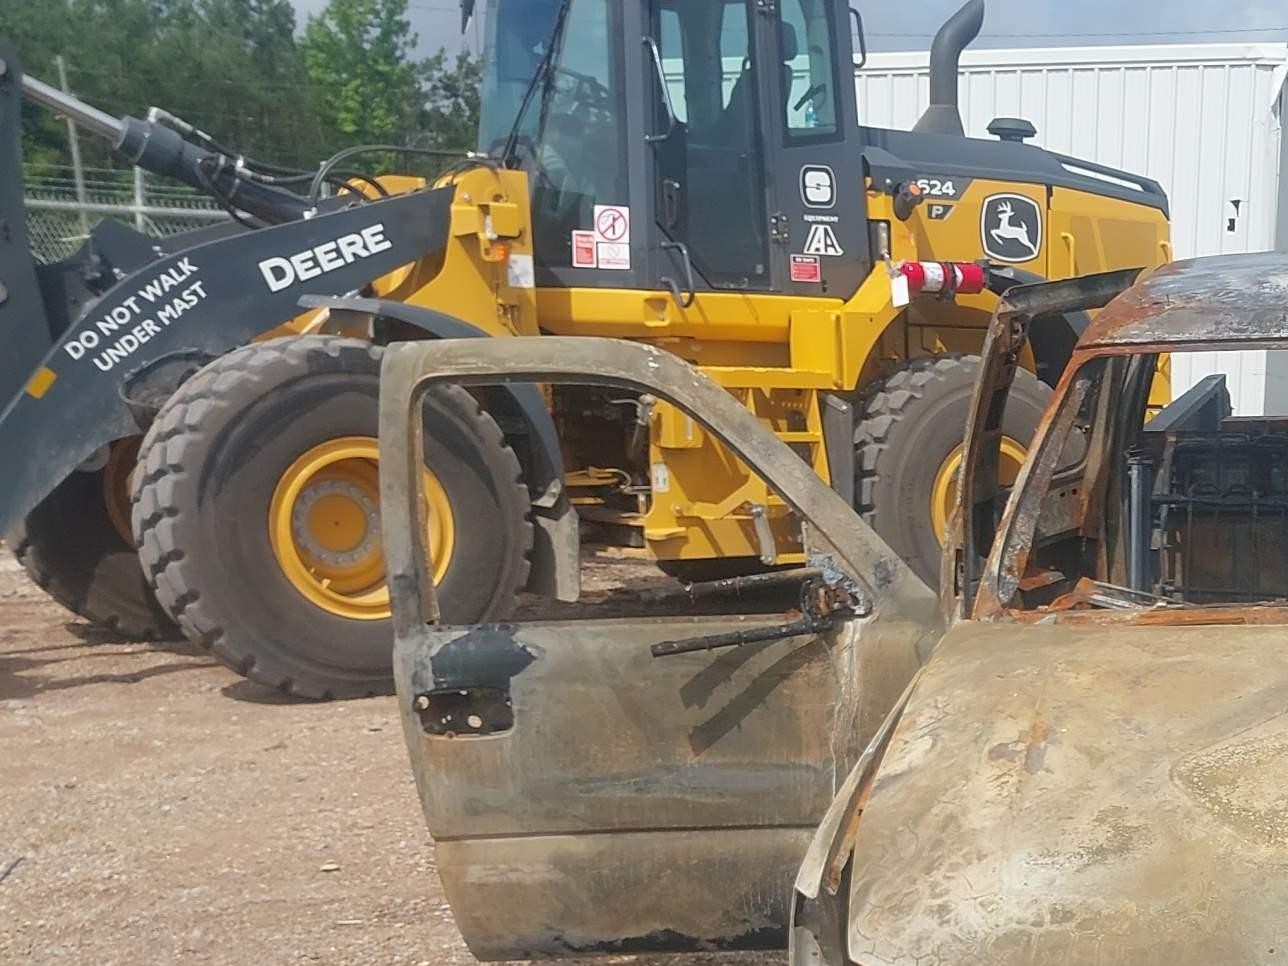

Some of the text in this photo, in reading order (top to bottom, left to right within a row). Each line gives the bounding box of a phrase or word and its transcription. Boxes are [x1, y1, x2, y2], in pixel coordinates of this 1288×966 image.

[931, 205, 944, 218] P
[258, 223, 392, 292] DEERE
[64, 257, 199, 360] DO NOT WALK
[92, 281, 207, 372] UNDER MAST
